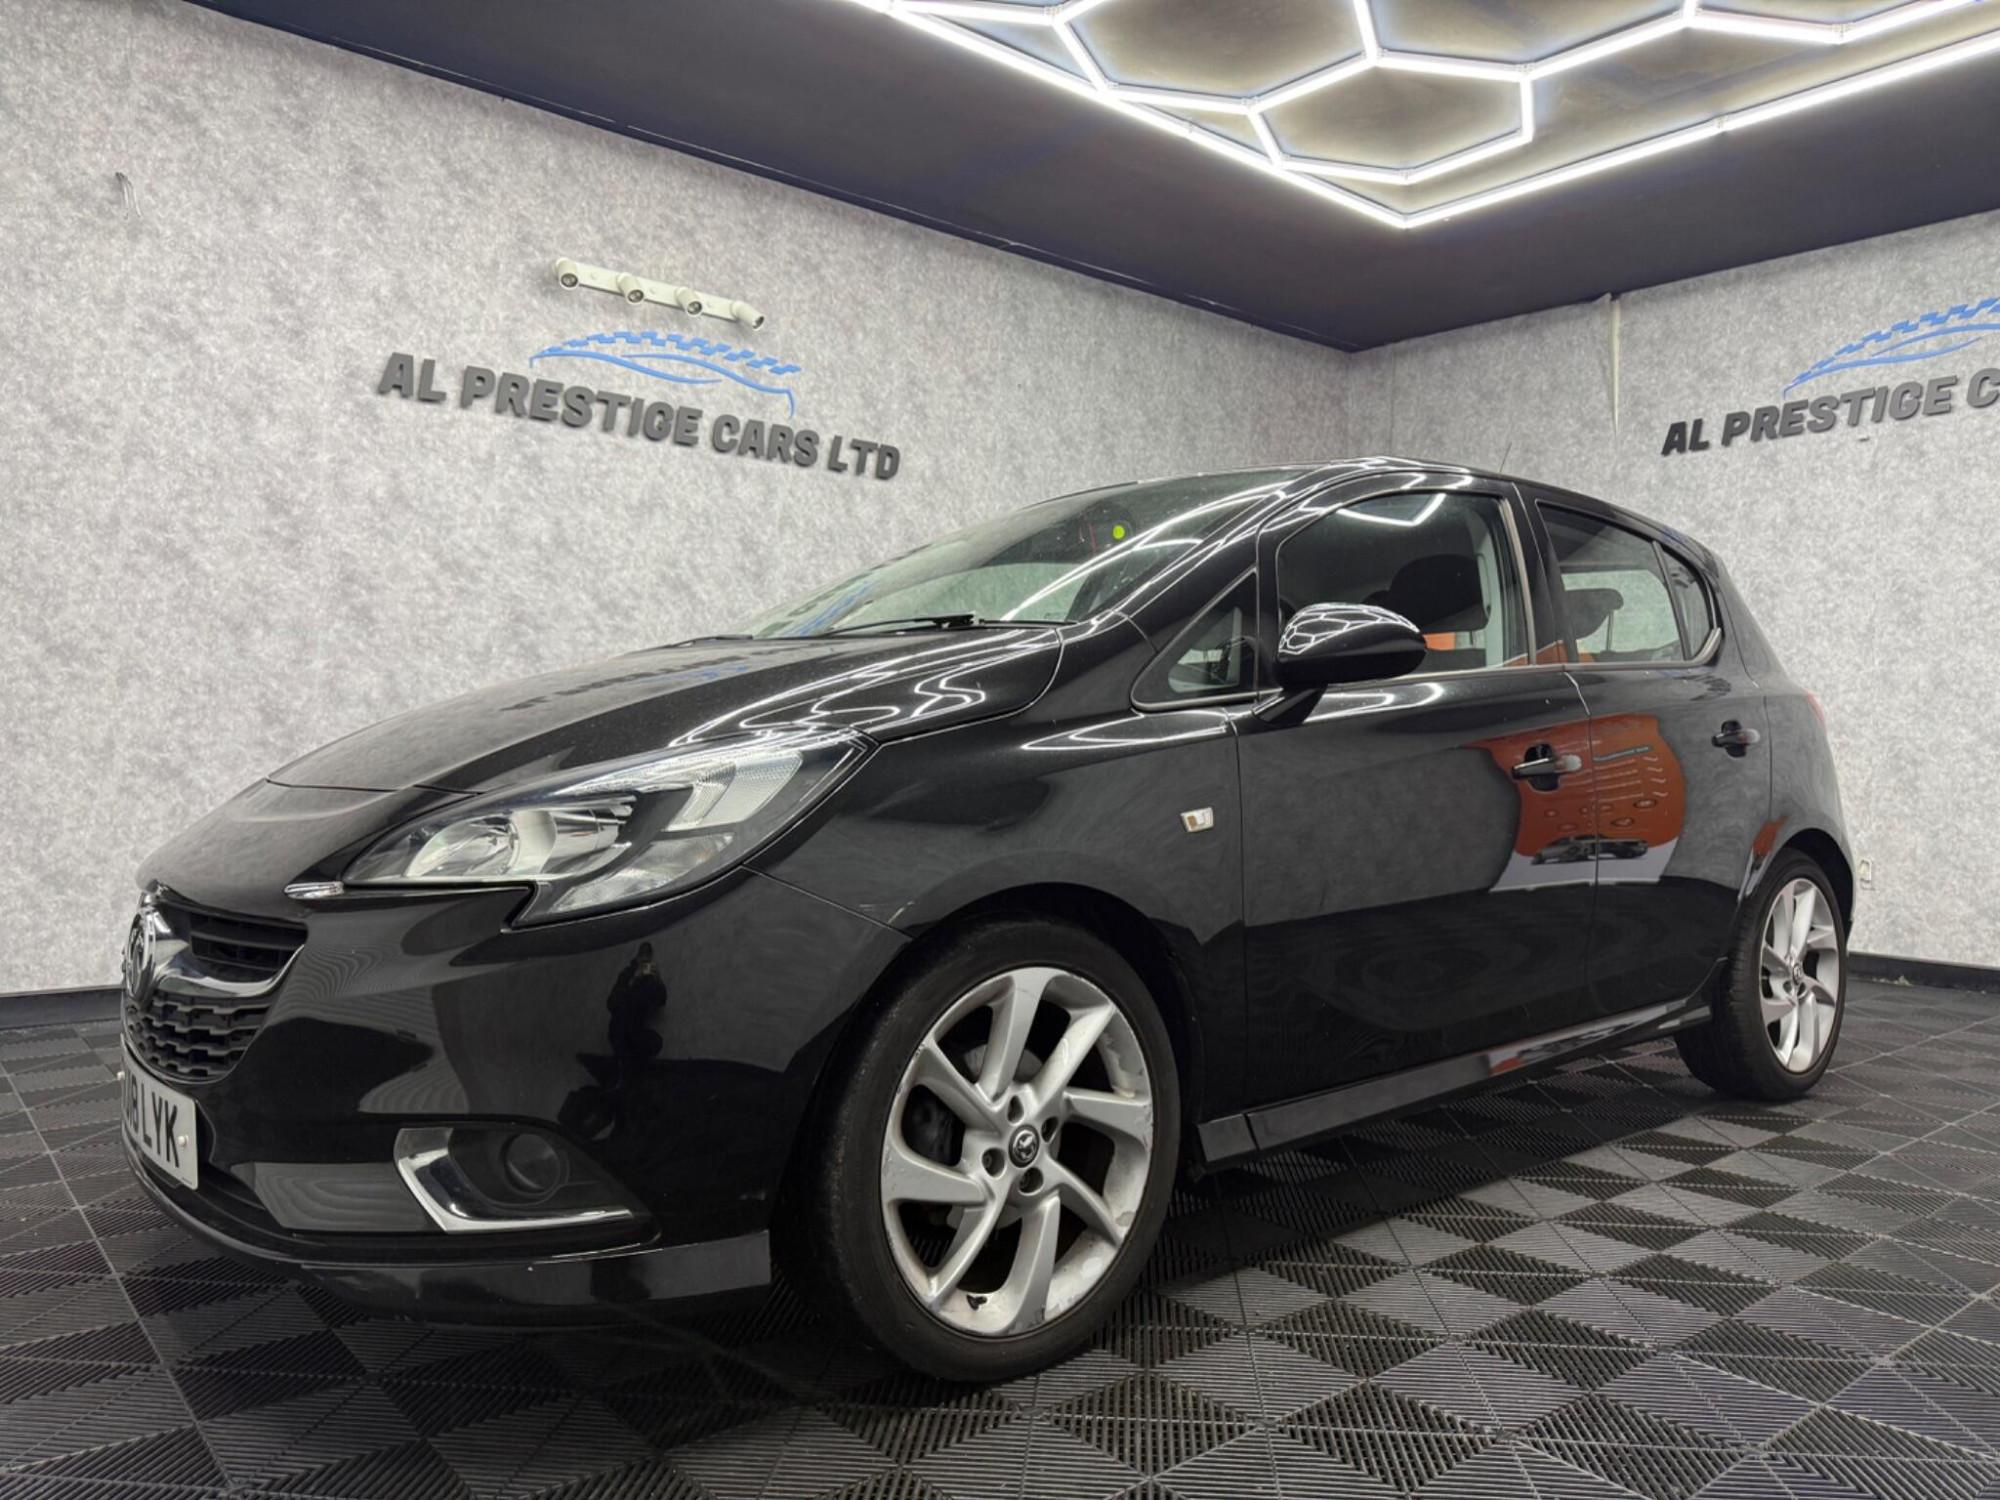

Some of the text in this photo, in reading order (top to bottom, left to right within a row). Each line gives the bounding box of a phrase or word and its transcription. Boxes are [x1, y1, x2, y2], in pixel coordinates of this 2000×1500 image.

[378, 352, 900, 480] AL PRESTIGE CARS LTD
[1661, 418, 1710, 457] AL
[1721, 375, 1959, 447] PRESTIGE
